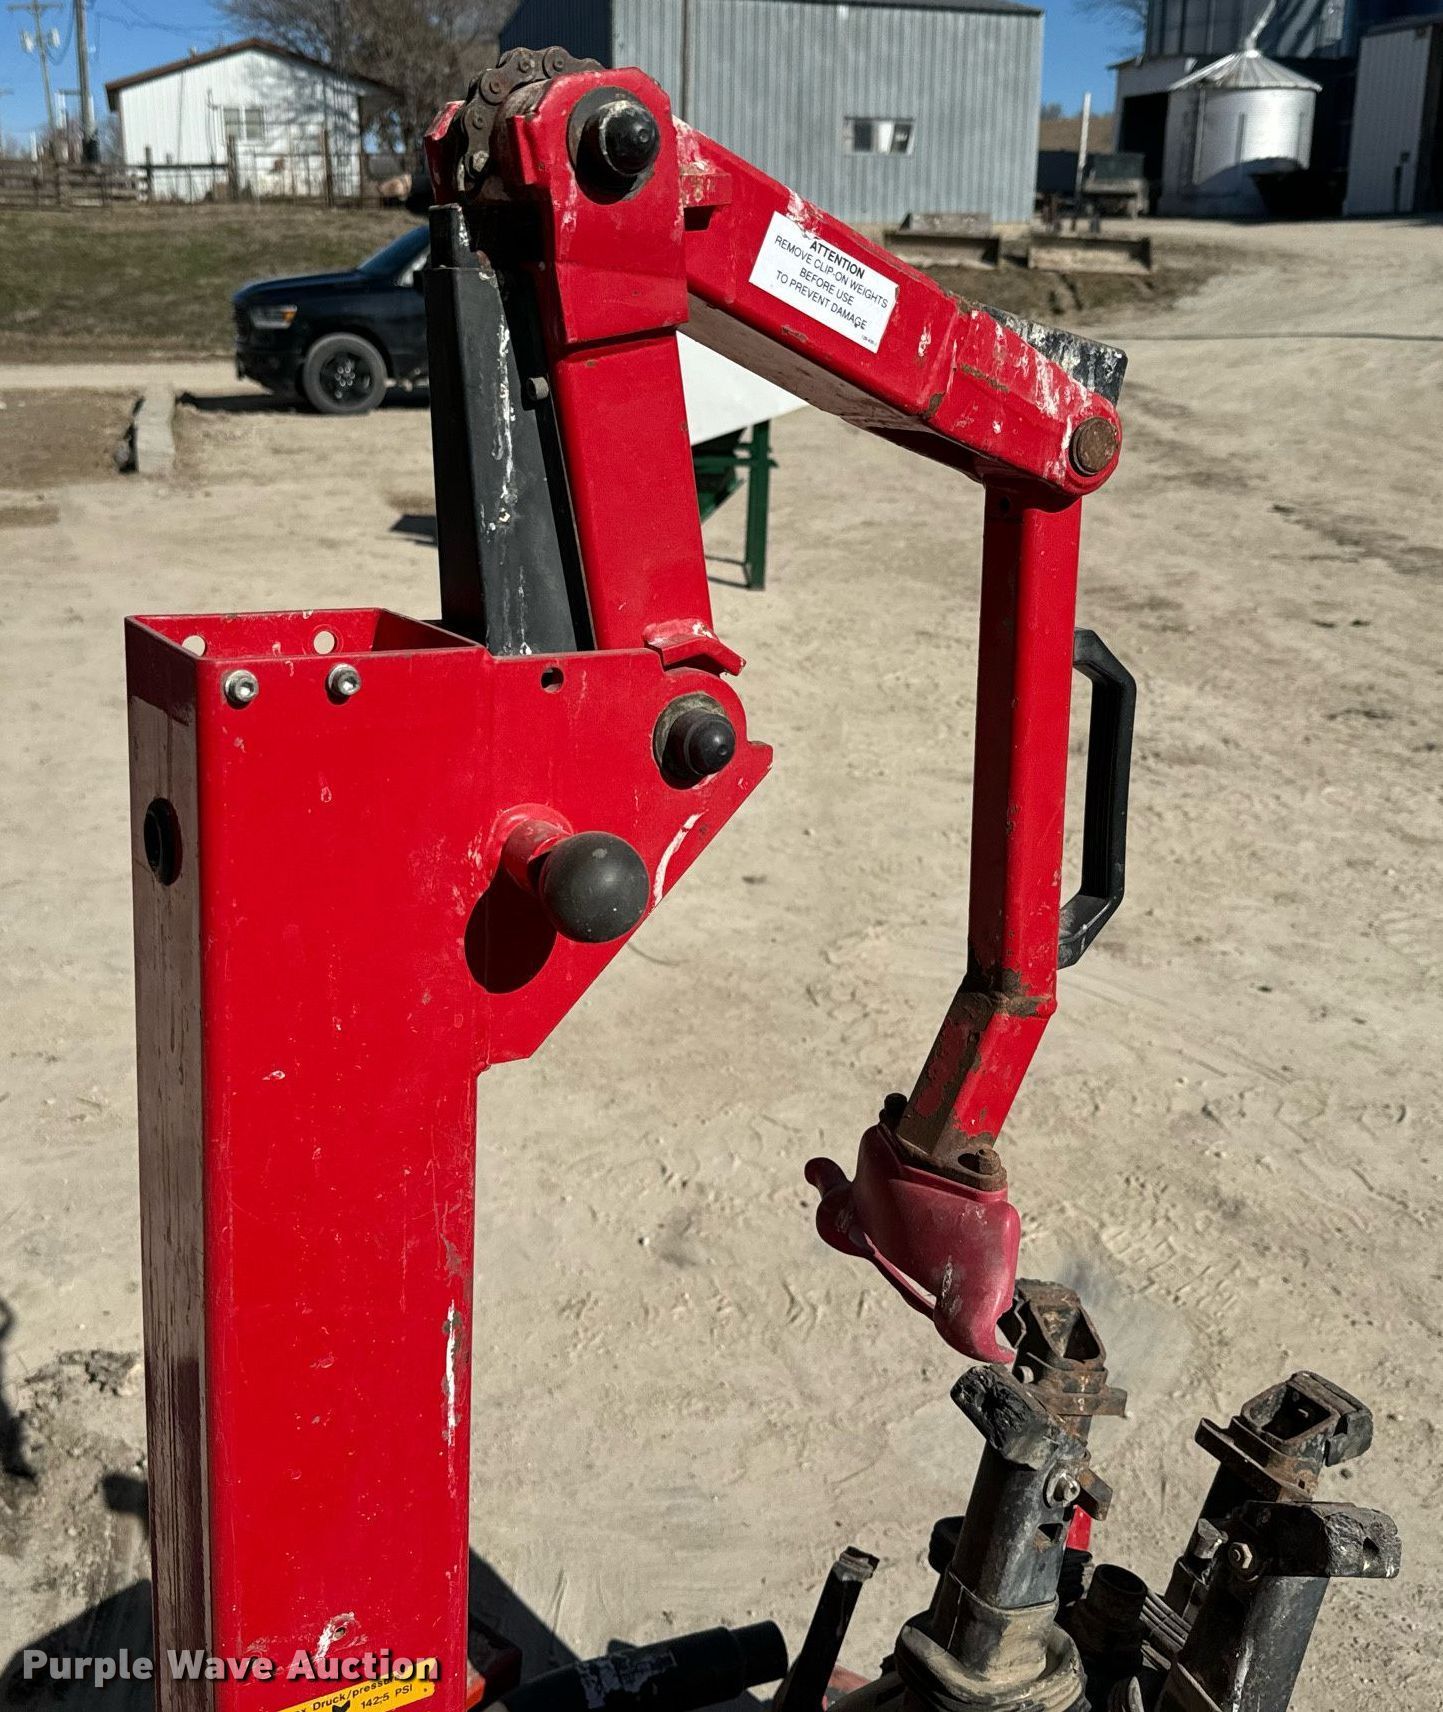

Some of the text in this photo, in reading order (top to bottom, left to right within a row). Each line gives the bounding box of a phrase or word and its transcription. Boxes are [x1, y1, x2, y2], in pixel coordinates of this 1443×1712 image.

[774, 235, 889, 309] REMOVE CLIP-ON WEIGHTS
[809, 240, 866, 279] ATTENTION
[776, 270, 868, 330] TO PREVENT DAMAGE
[799, 267, 855, 306] BEFORE USE
[394, 1683, 413, 1698] PSI
